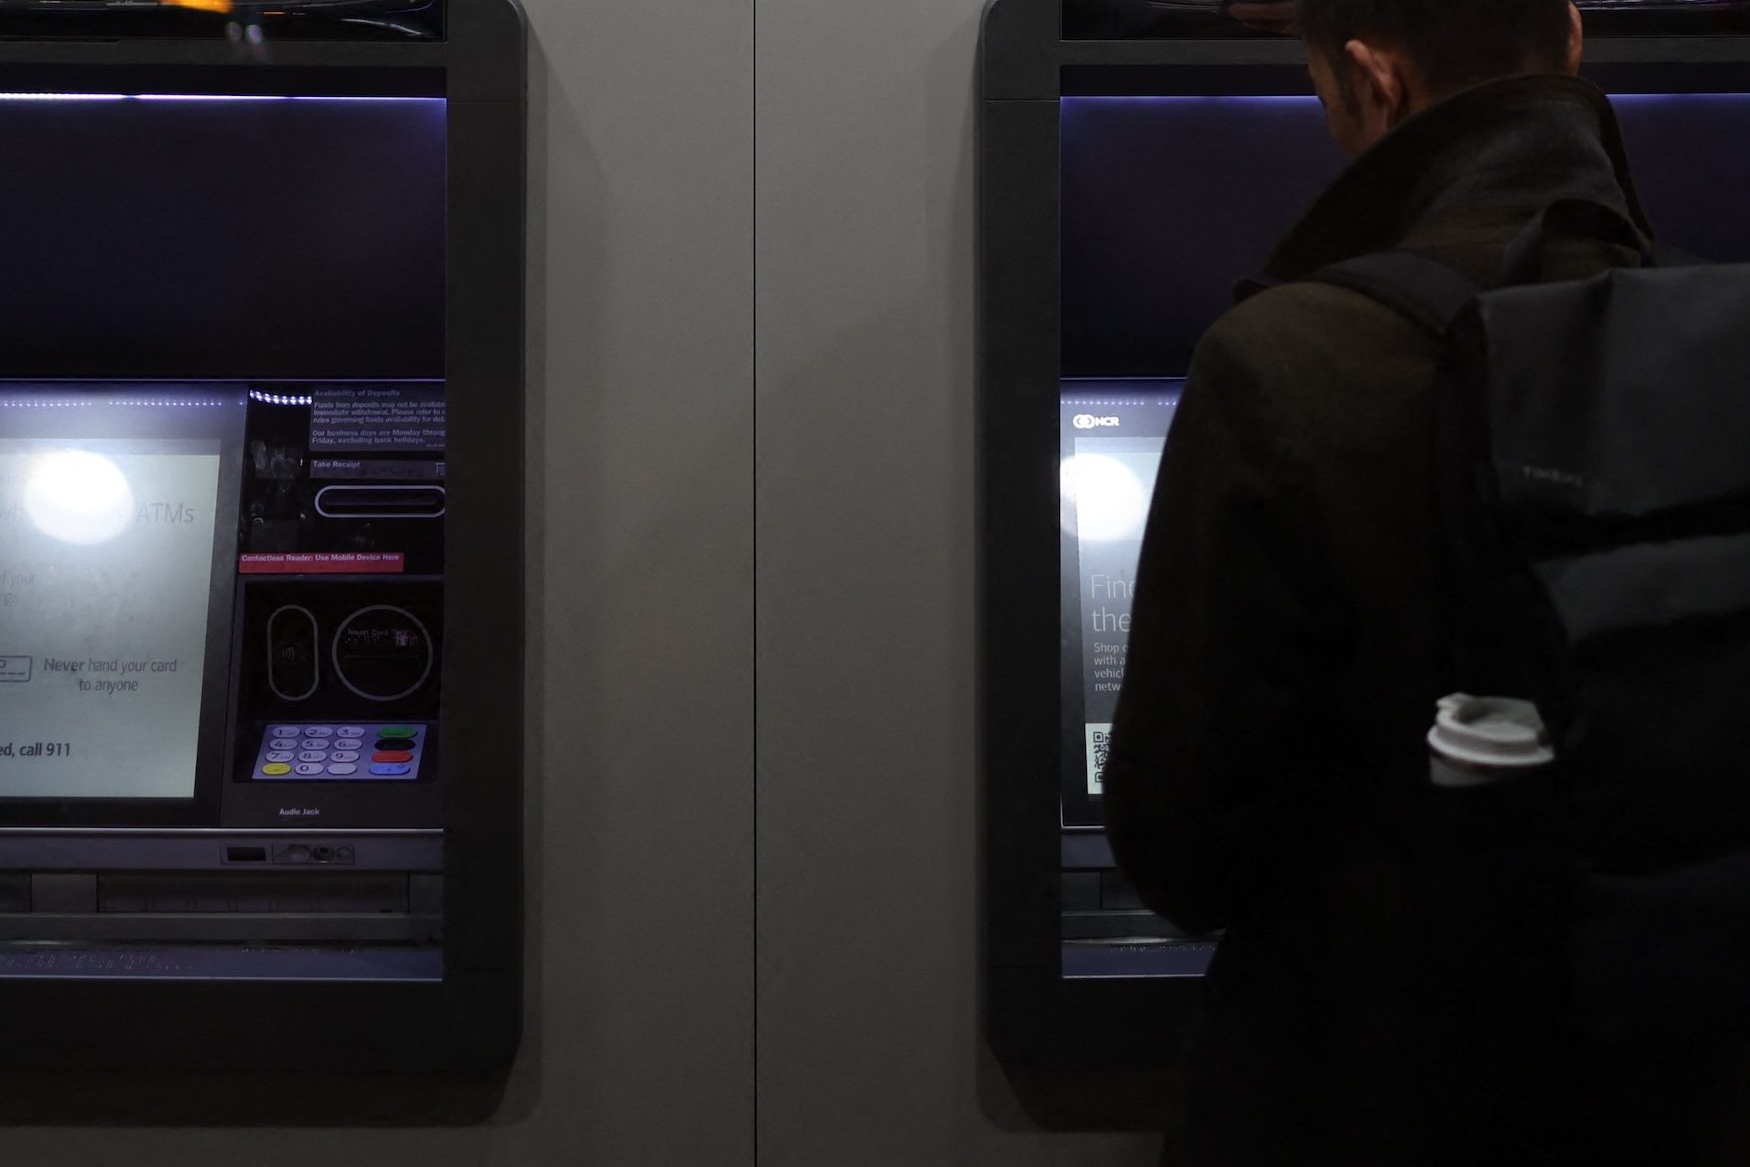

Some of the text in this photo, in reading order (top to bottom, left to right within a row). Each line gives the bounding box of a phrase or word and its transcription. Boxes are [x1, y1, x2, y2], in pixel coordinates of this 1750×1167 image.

[1095, 416, 1120, 426] NCR
[392, 429, 420, 437] Monday
[332, 461, 360, 469] Receipt
[136, 501, 195, 523] ATMs
[1092, 606, 1131, 632] the
[1094, 642, 1119, 654] Shop
[1094, 655, 1117, 665] with
[44, 658, 177, 675] Never hand your card
[79, 679, 139, 695] to anyone
[19, 742, 43, 756] call
[45, 742, 71, 757] 911
[279, 807, 320, 816] Audio Jack
